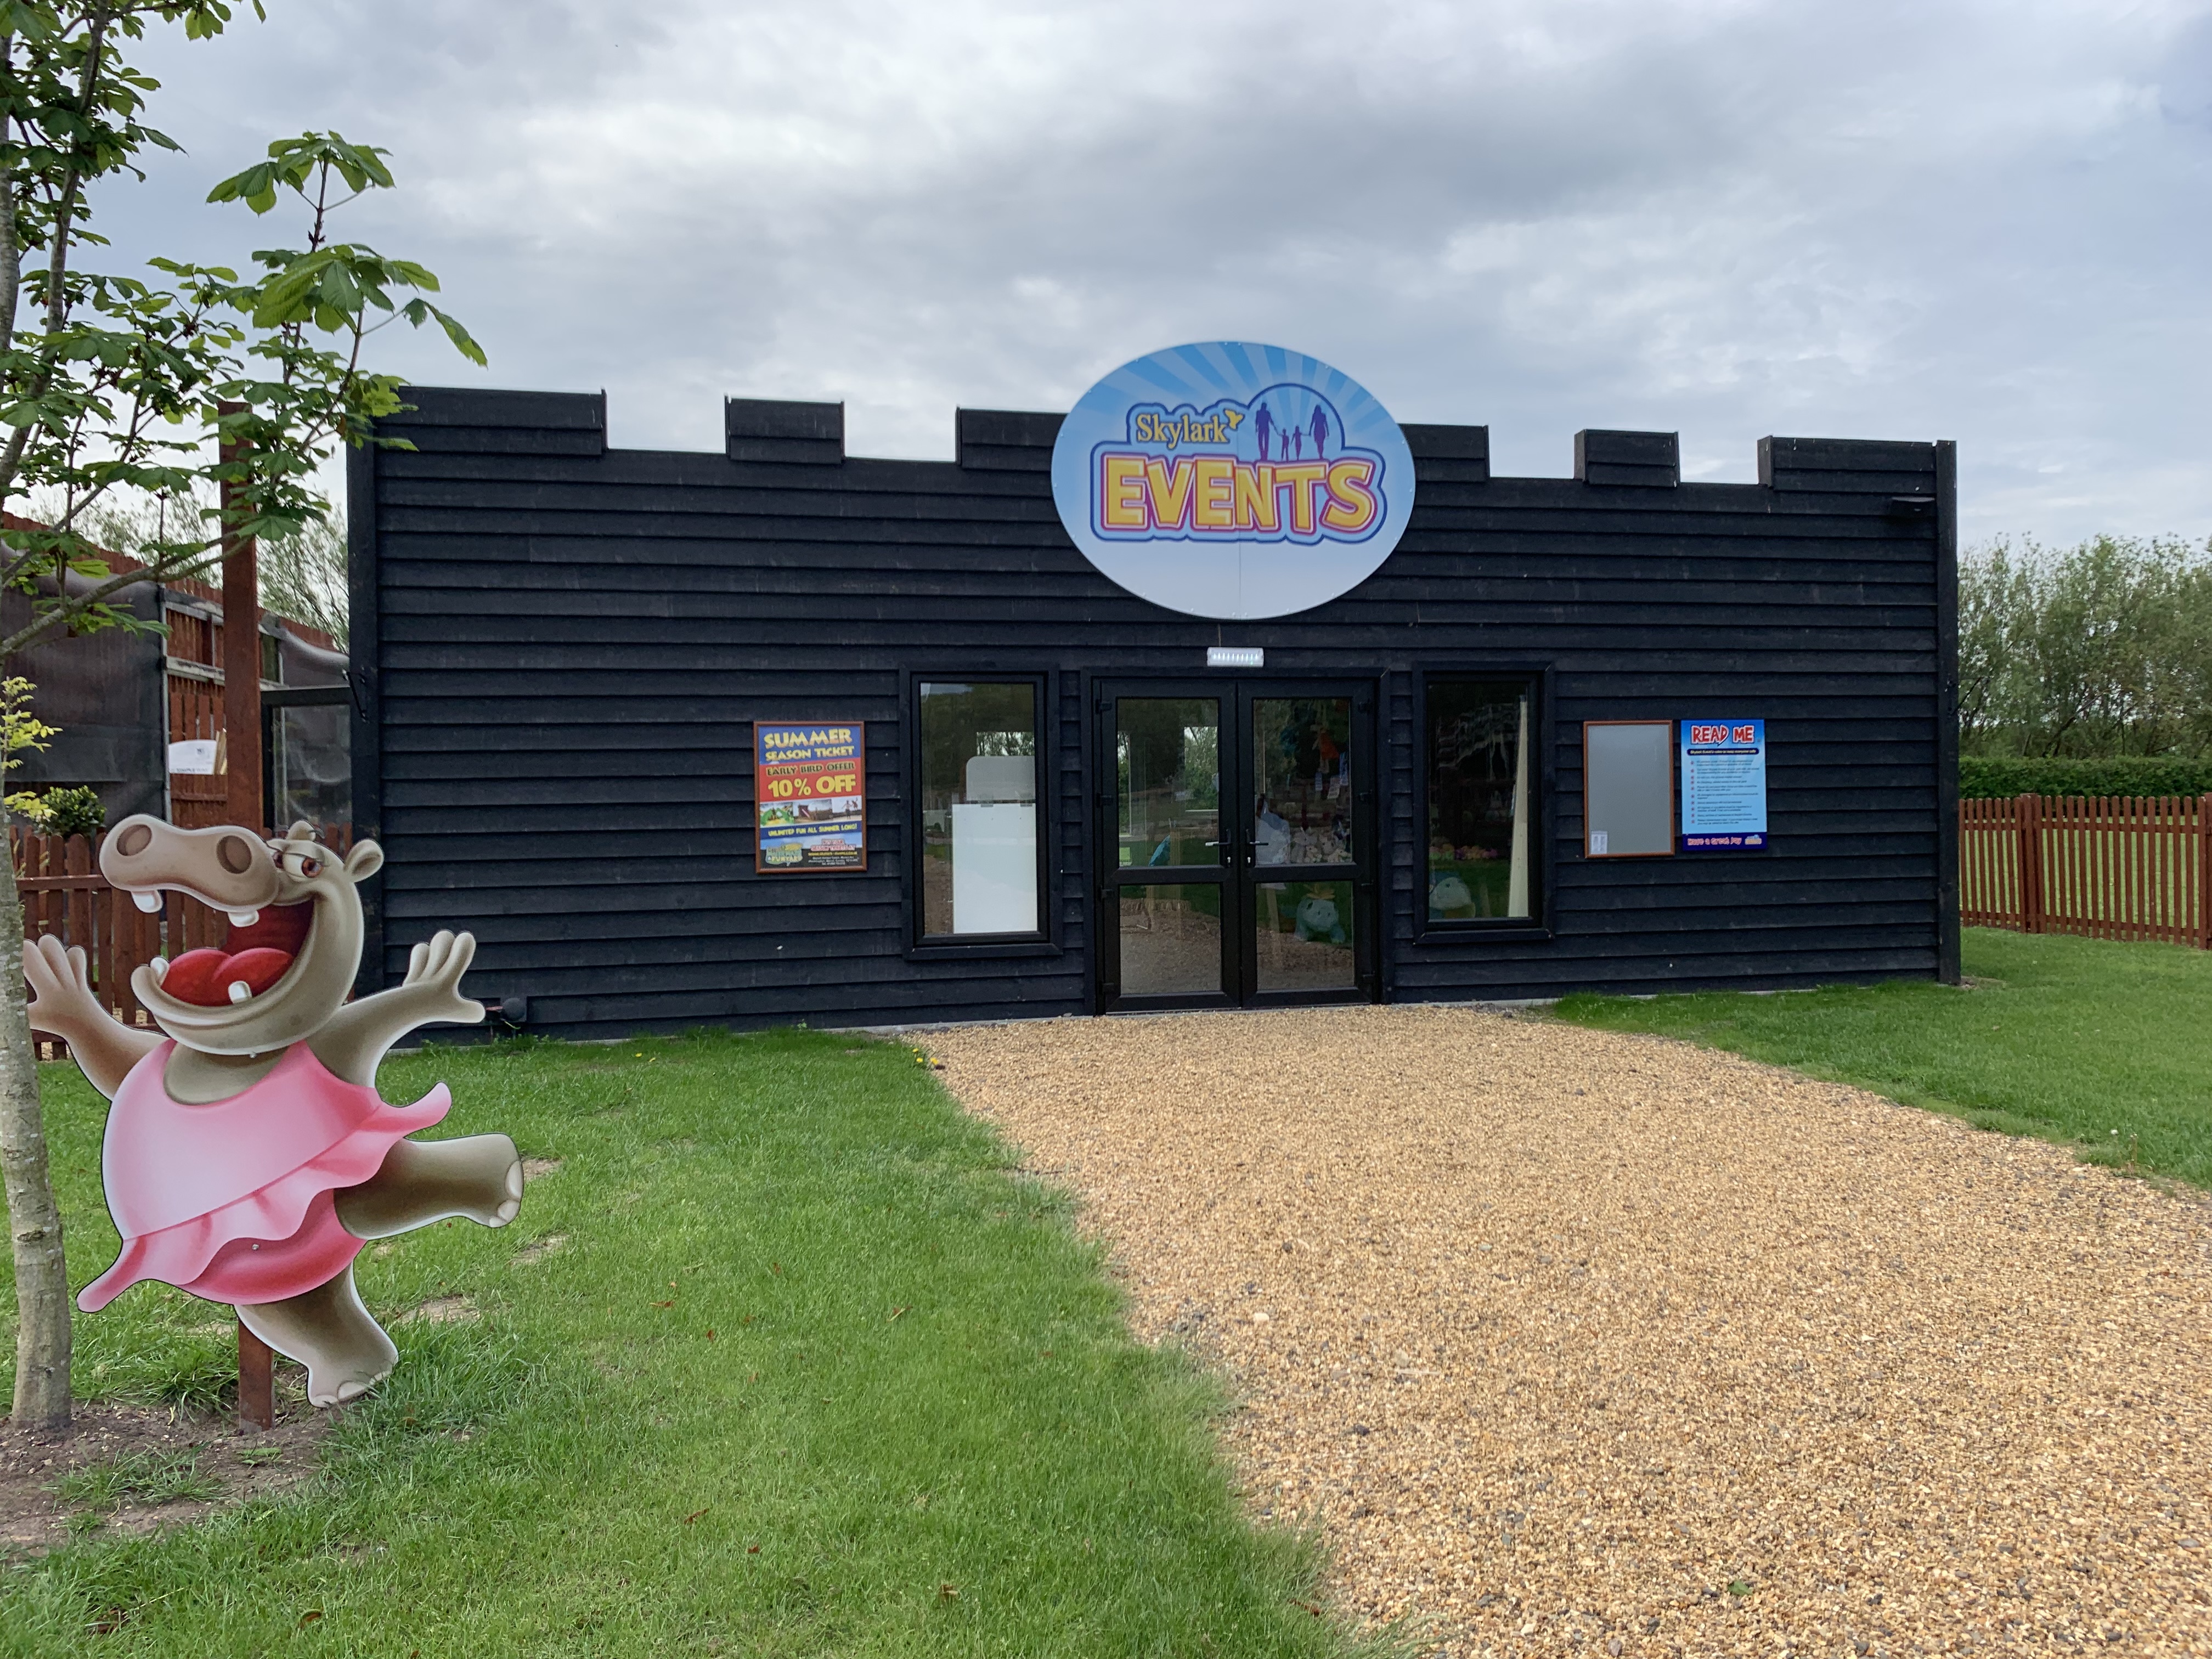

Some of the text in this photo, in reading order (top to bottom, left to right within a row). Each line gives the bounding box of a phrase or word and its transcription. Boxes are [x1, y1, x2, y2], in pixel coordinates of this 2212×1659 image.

[1136, 413, 1229, 449] Skylark
[1102, 454, 1376, 535] EVENTS
[764, 729, 852, 748] SUMMER
[1691, 725, 1754, 745] READ ME
[765, 746, 855, 761] SEASON TICKET
[766, 761, 855, 776] EARLY BIRD OFFER
[768, 774, 856, 798] 10% OFF
